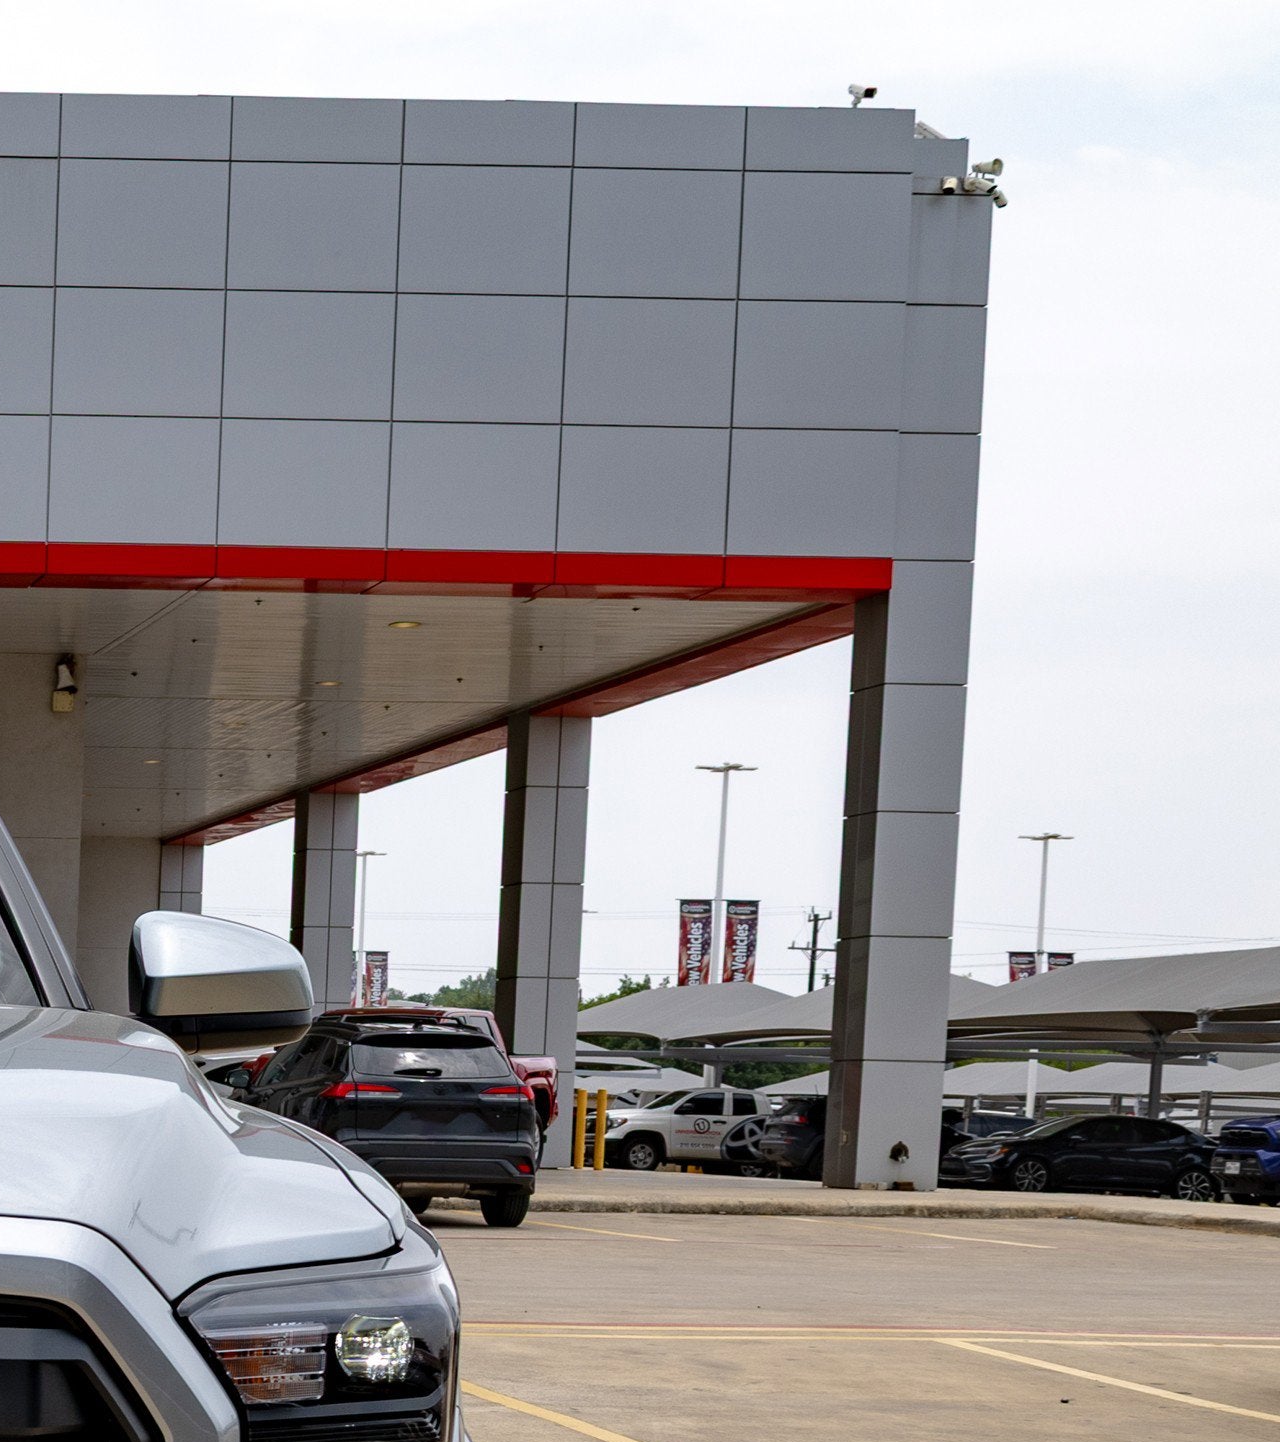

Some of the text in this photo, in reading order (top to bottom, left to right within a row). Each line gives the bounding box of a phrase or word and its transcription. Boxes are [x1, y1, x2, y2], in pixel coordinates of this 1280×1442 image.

[686, 922, 703, 969] Vehicles
[731, 923, 749, 970] Vehicles
[688, 970, 700, 986] ew
